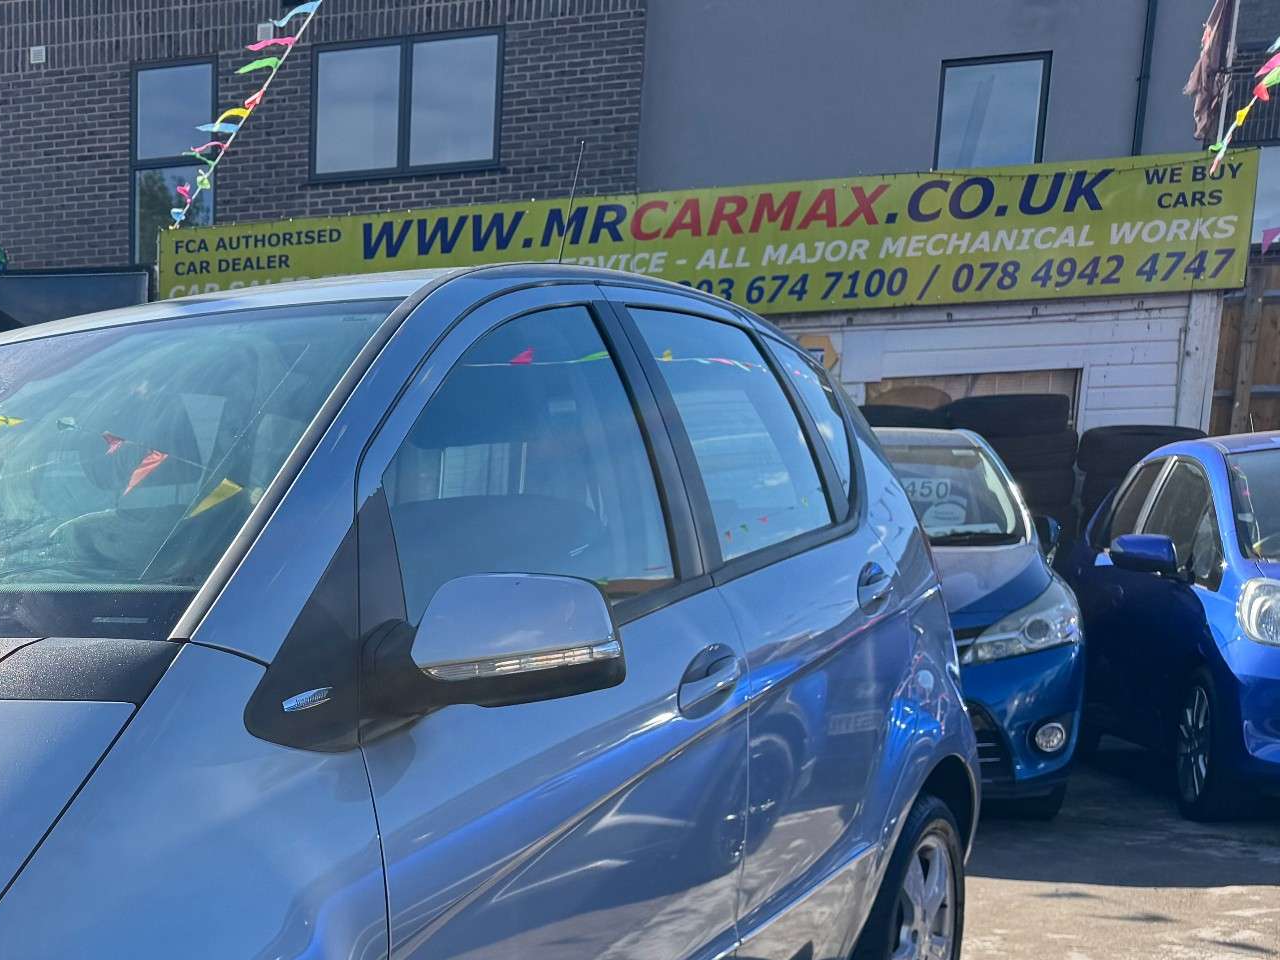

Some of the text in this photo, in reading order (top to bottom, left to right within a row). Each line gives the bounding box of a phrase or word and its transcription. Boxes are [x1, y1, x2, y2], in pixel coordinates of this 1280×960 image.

[1144, 161, 1244, 185] WE BUY
[1157, 189, 1223, 209] CARS
[362, 167, 1116, 261] WWW.MRCARMAX.CO.UK
[174, 228, 343, 255] FCA AUTHORISED
[695, 246, 752, 271] ALL
[760, 238, 871, 267] MAJOR
[878, 224, 1096, 259] MECHANICAL
[1108, 215, 1239, 245] WORKS
[174, 254, 291, 276] CAR DEALER
[745, 272, 810, 305] 674
[820, 266, 909, 301] 7100
[916, 264, 942, 301] /
[951, 260, 1021, 294] 078
[1030, 255, 1125, 289] 4942
[1135, 248, 1237, 283] 4747
